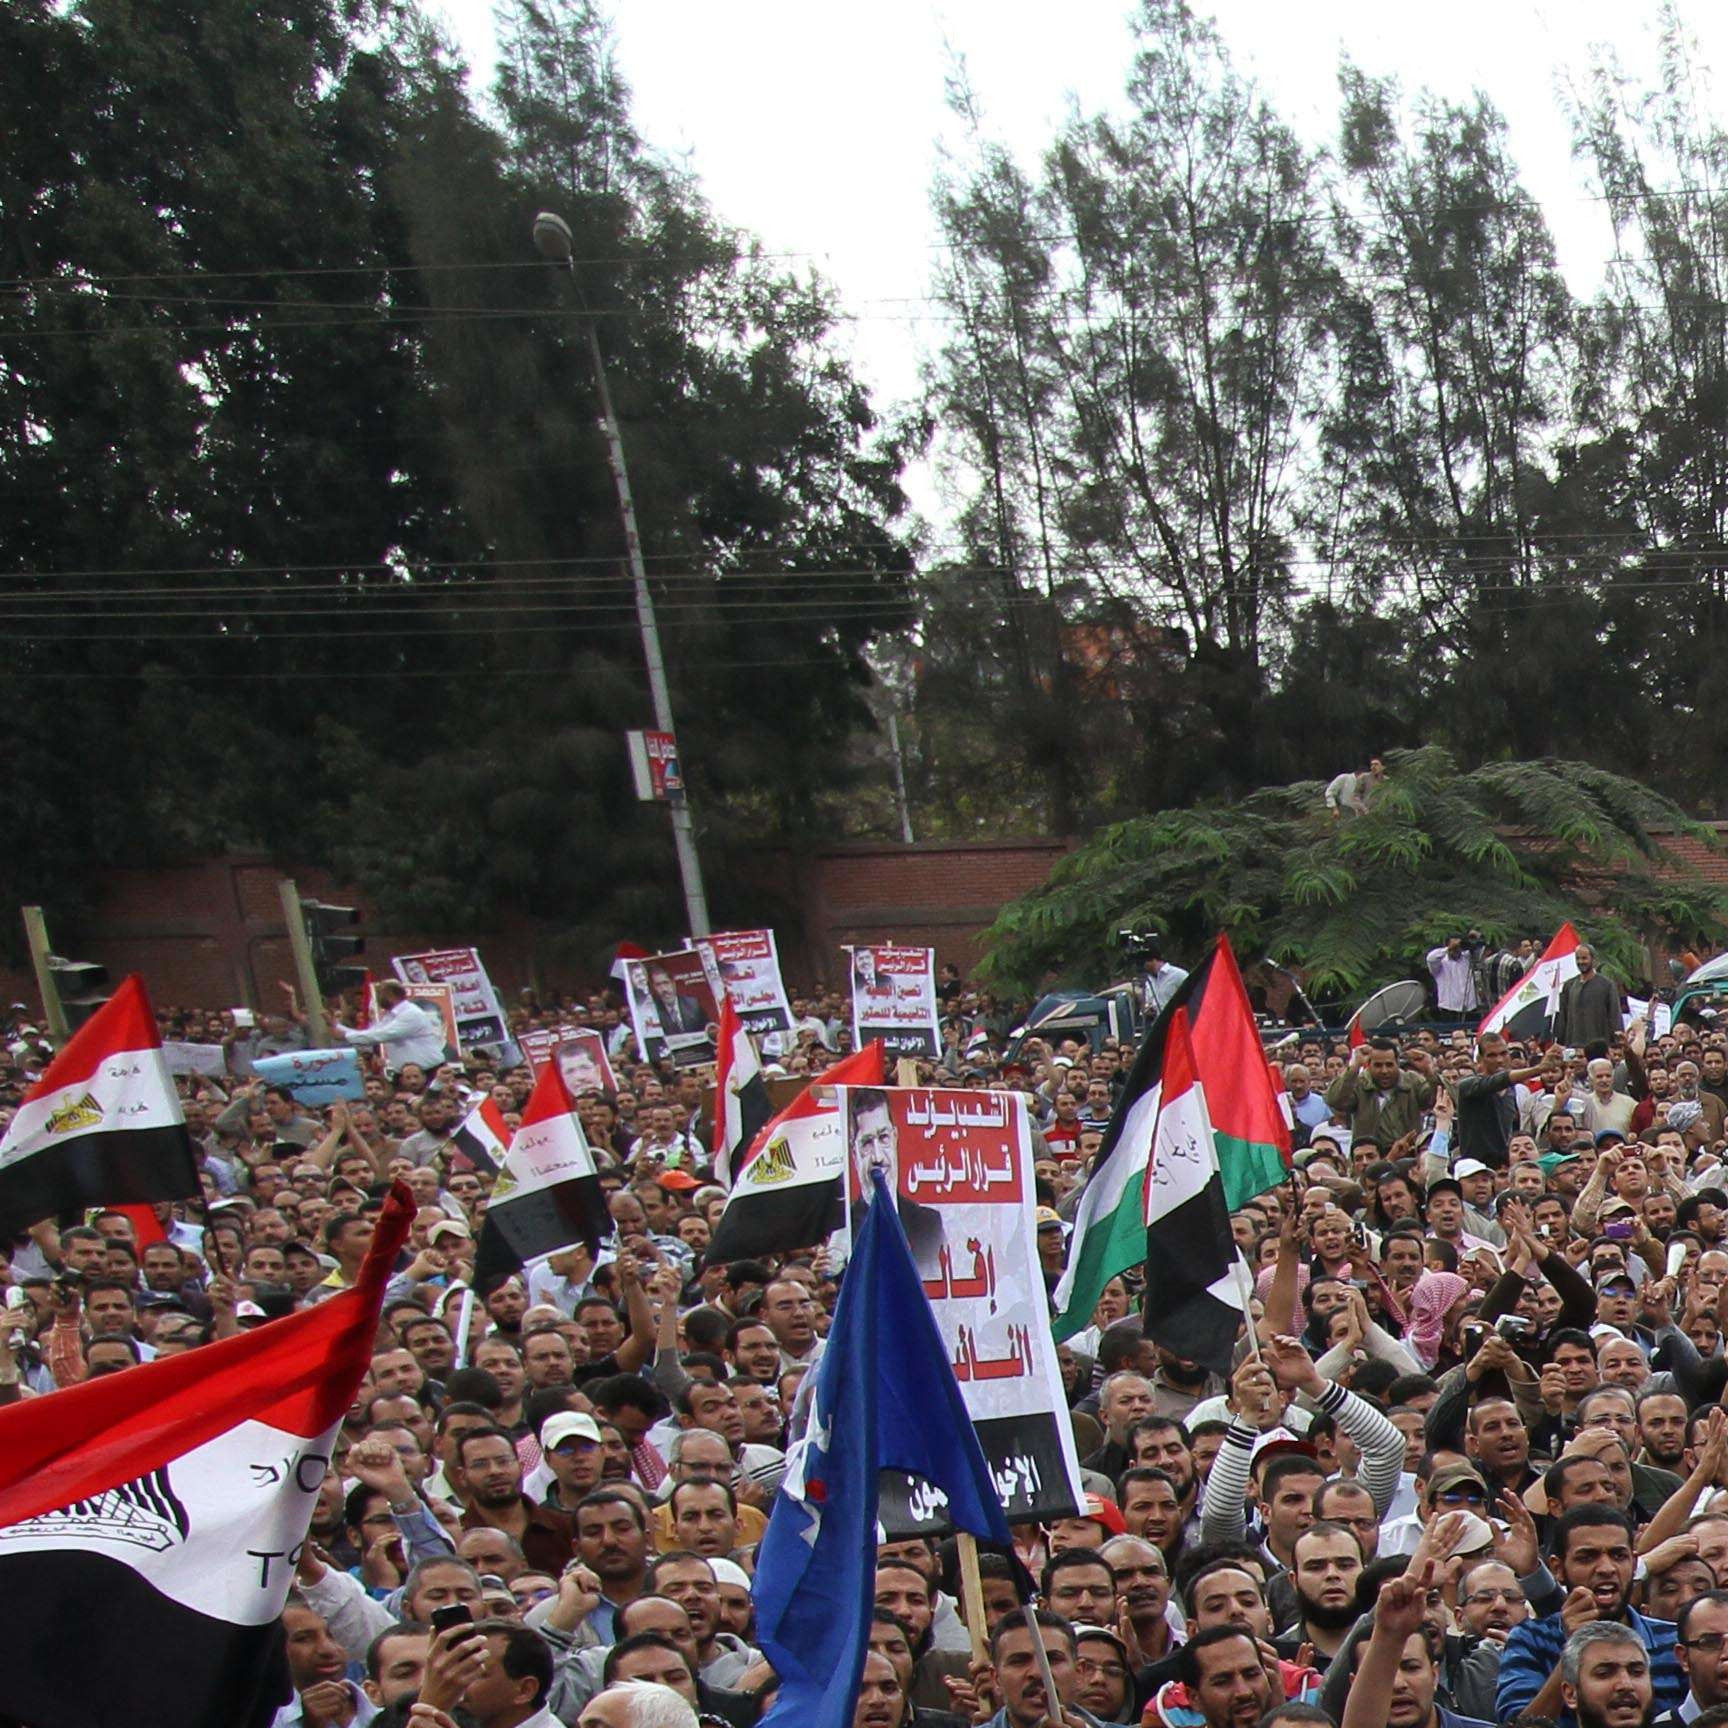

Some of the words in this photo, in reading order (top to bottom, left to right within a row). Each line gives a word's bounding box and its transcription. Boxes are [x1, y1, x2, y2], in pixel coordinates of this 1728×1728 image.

[906, 1092, 958, 1139] يؤيد
[957, 1092, 1009, 1137] الشعب
[908, 1144, 974, 1194] الرئيس
[973, 1144, 1013, 1192] قرار
[922, 1236, 997, 1316] إقال
[988, 1454, 1042, 1508] الإخوا
